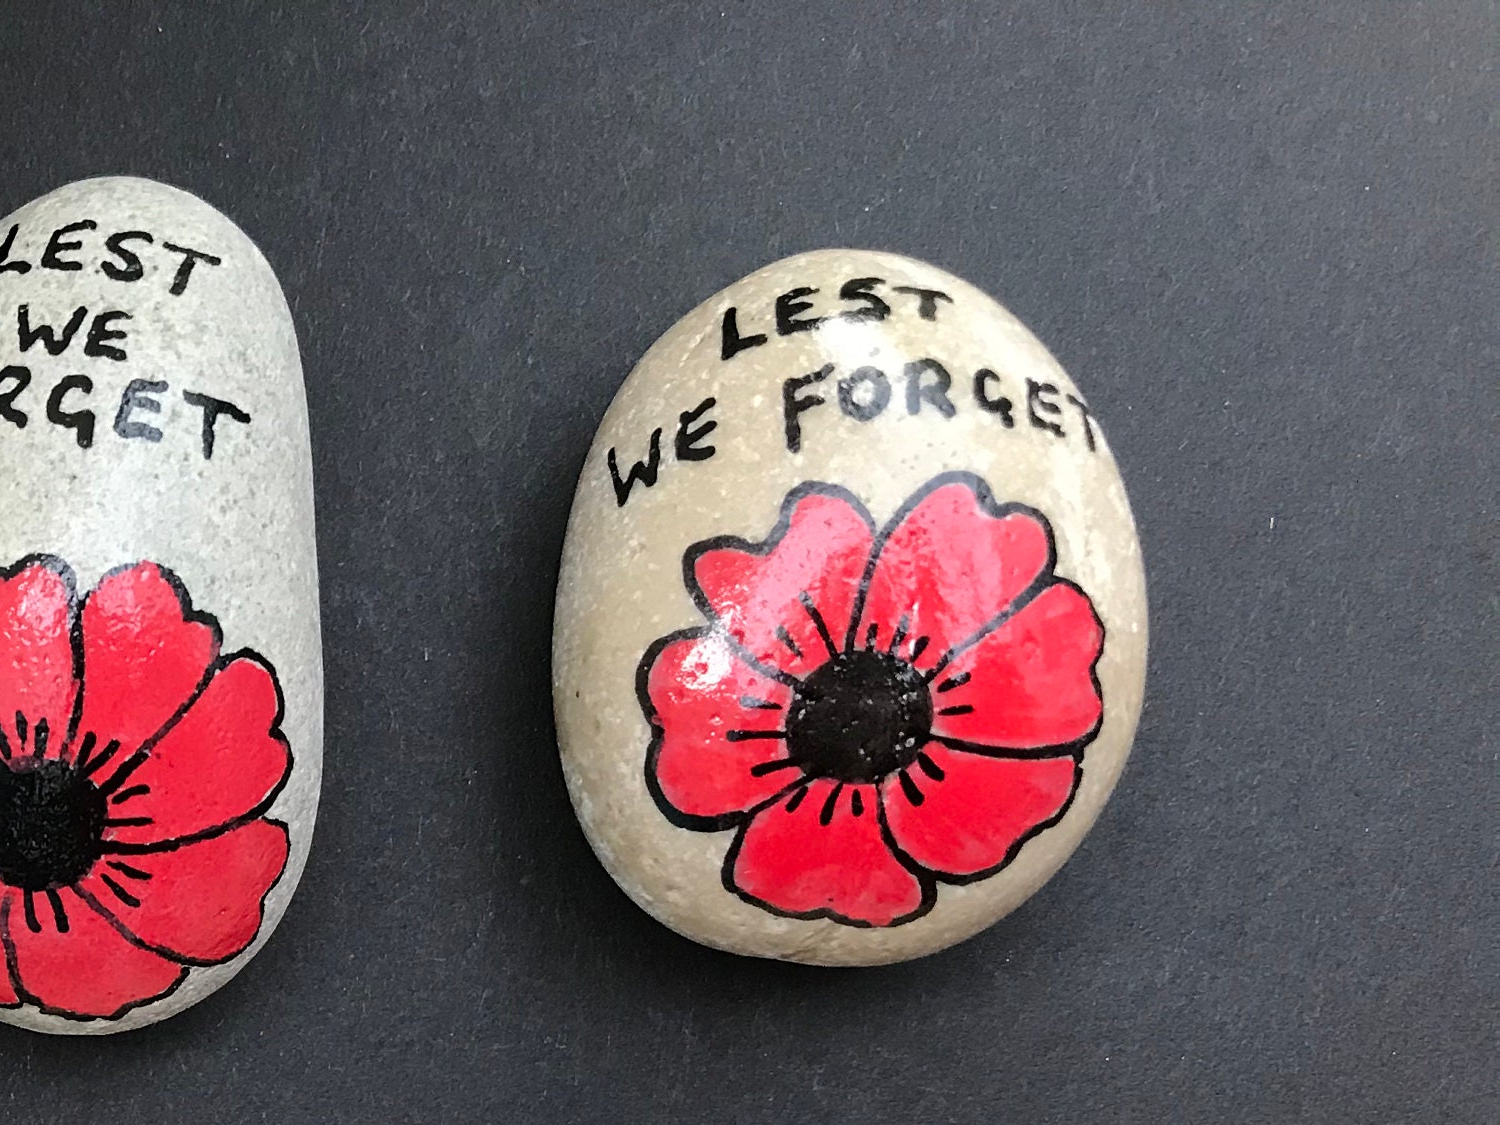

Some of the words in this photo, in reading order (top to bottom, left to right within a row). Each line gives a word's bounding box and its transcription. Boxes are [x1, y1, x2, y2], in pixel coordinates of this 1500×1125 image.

[17, 303, 134, 362] WE
[720, 276, 953, 362] LEST
[606, 397, 718, 508] WE
[781, 357, 1100, 453] FORGET
